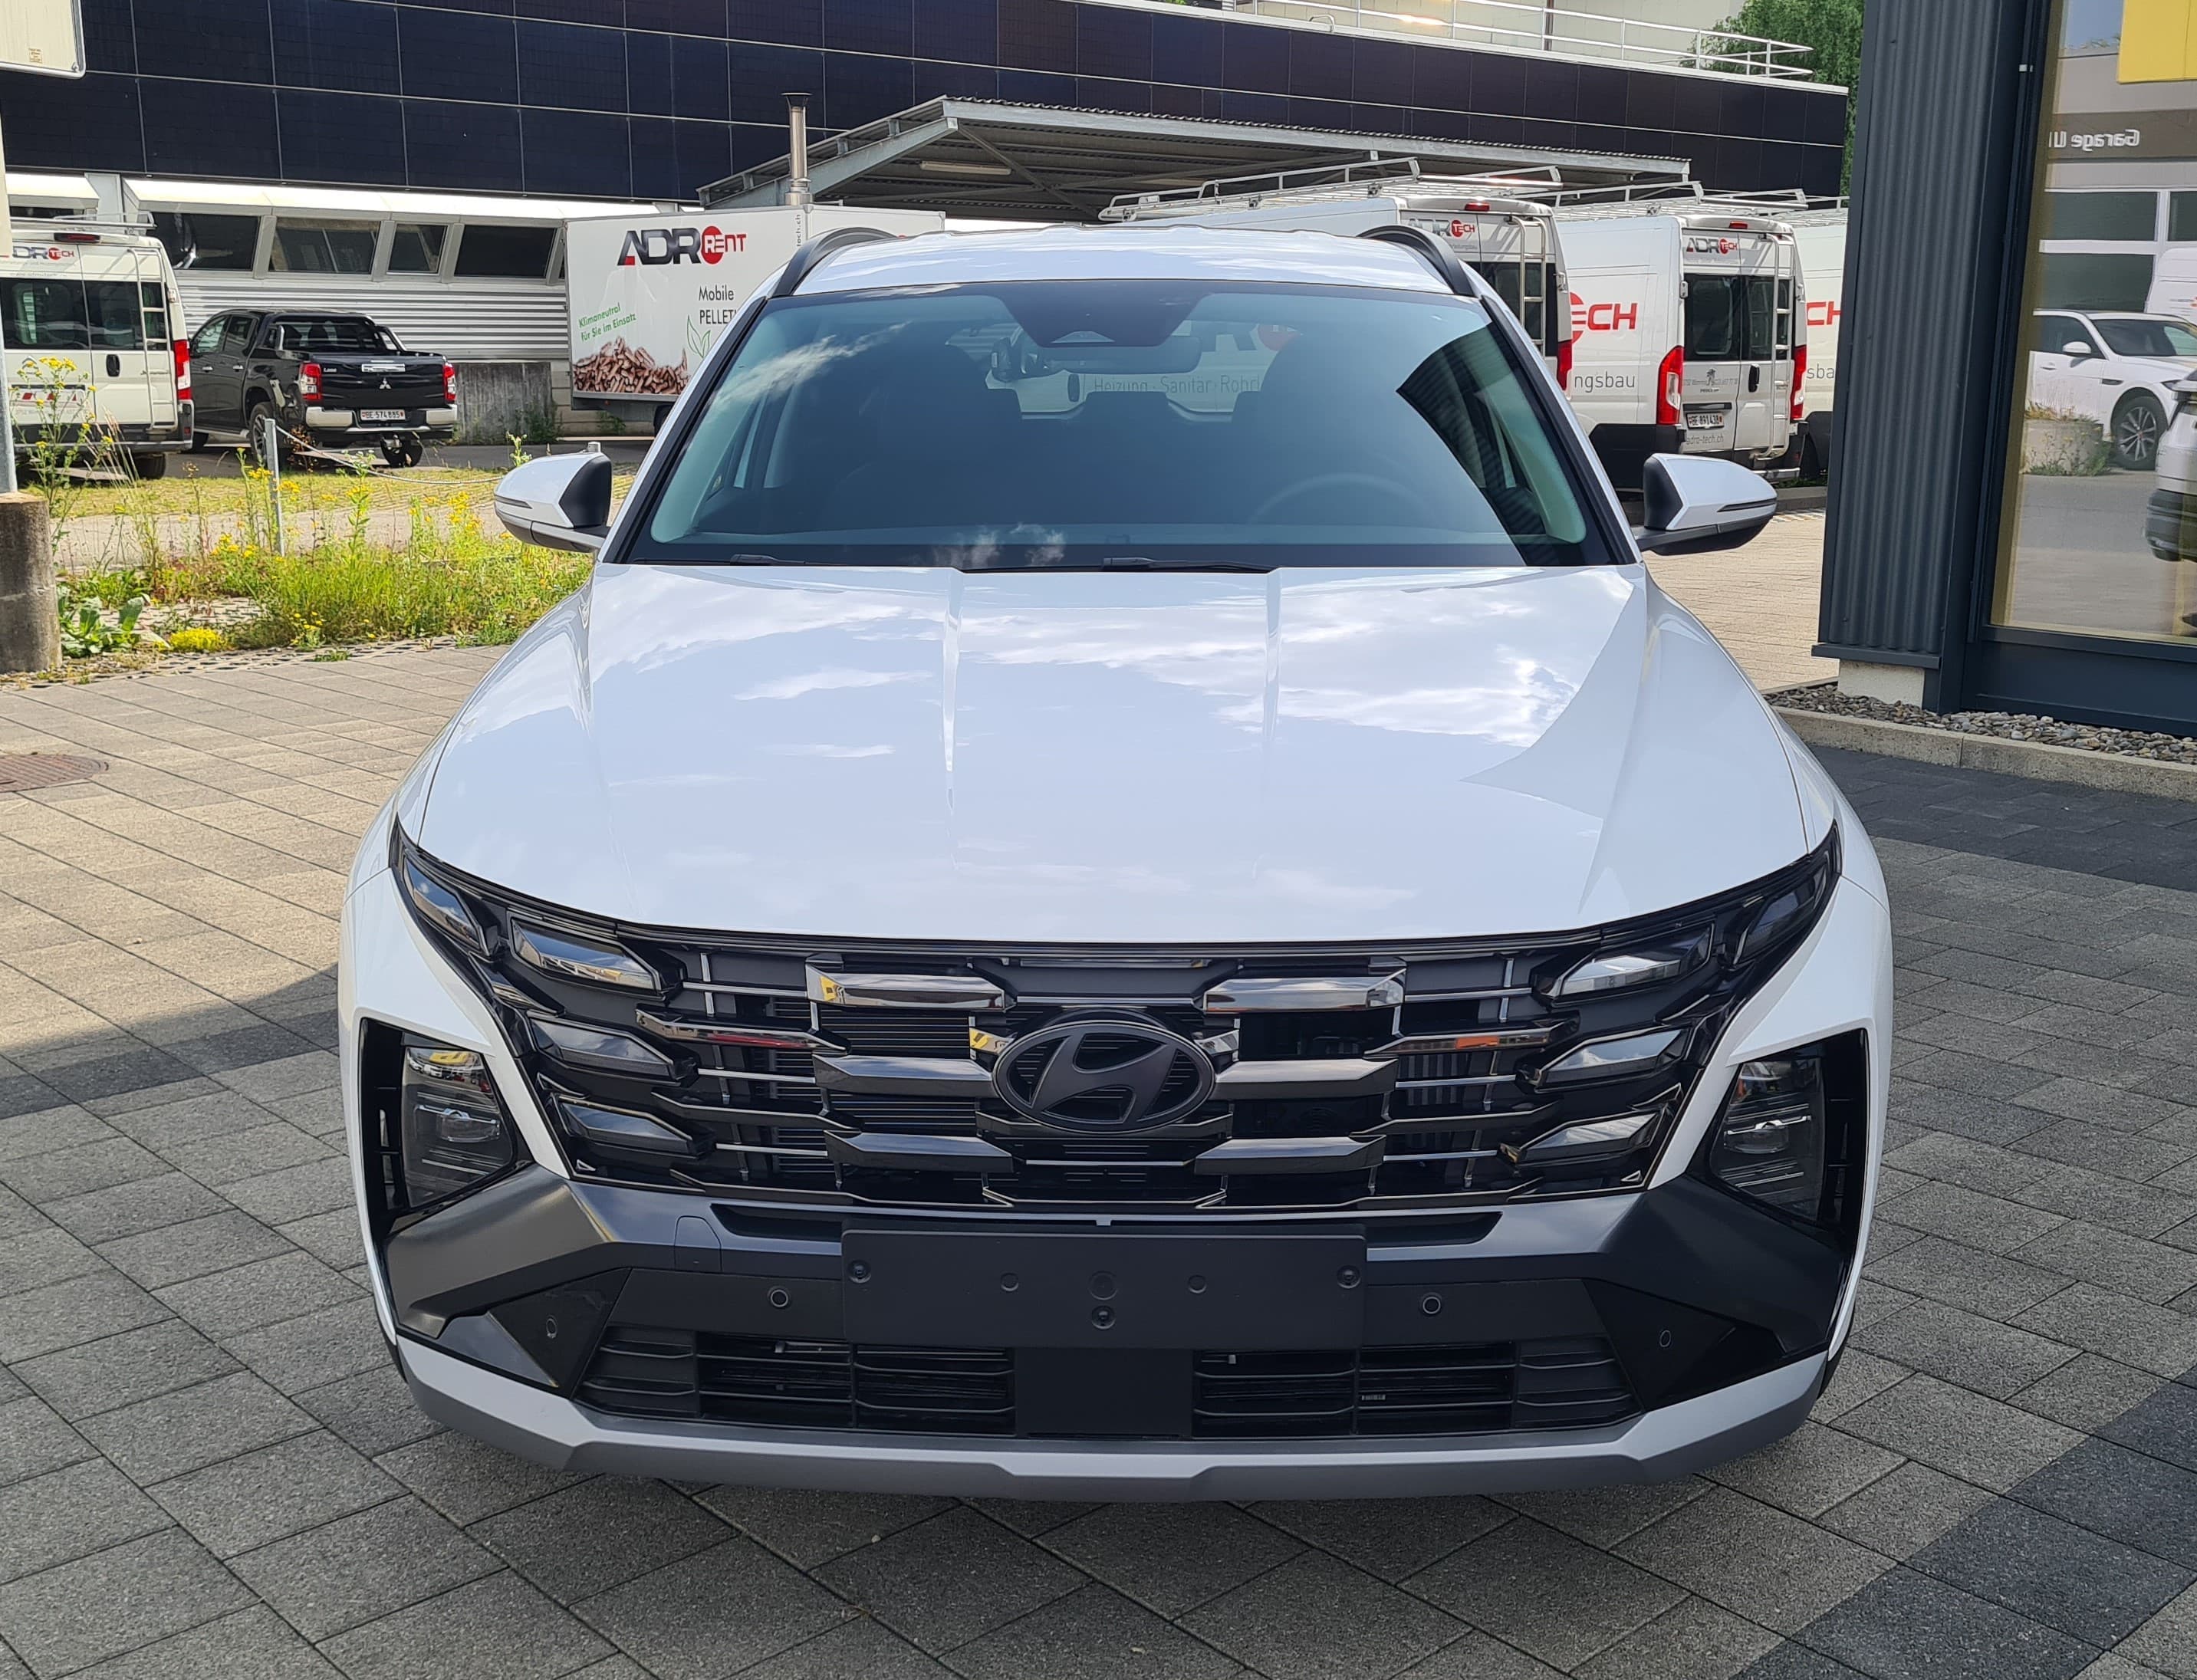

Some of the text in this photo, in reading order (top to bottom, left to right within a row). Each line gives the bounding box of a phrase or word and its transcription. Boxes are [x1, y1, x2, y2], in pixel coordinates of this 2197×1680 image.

[617, 228, 702, 266] ADR
[1686, 238, 1719, 253] ADR
[699, 284, 735, 301] Mobile
[578, 301, 621, 328] Klimaneutral
[580, 313, 636, 342] für Sie im Einsatz
[1574, 370, 1635, 393] ngsbau
[1806, 363, 1835, 380] sba
[1160, 375, 1210, 393] Sanitär
